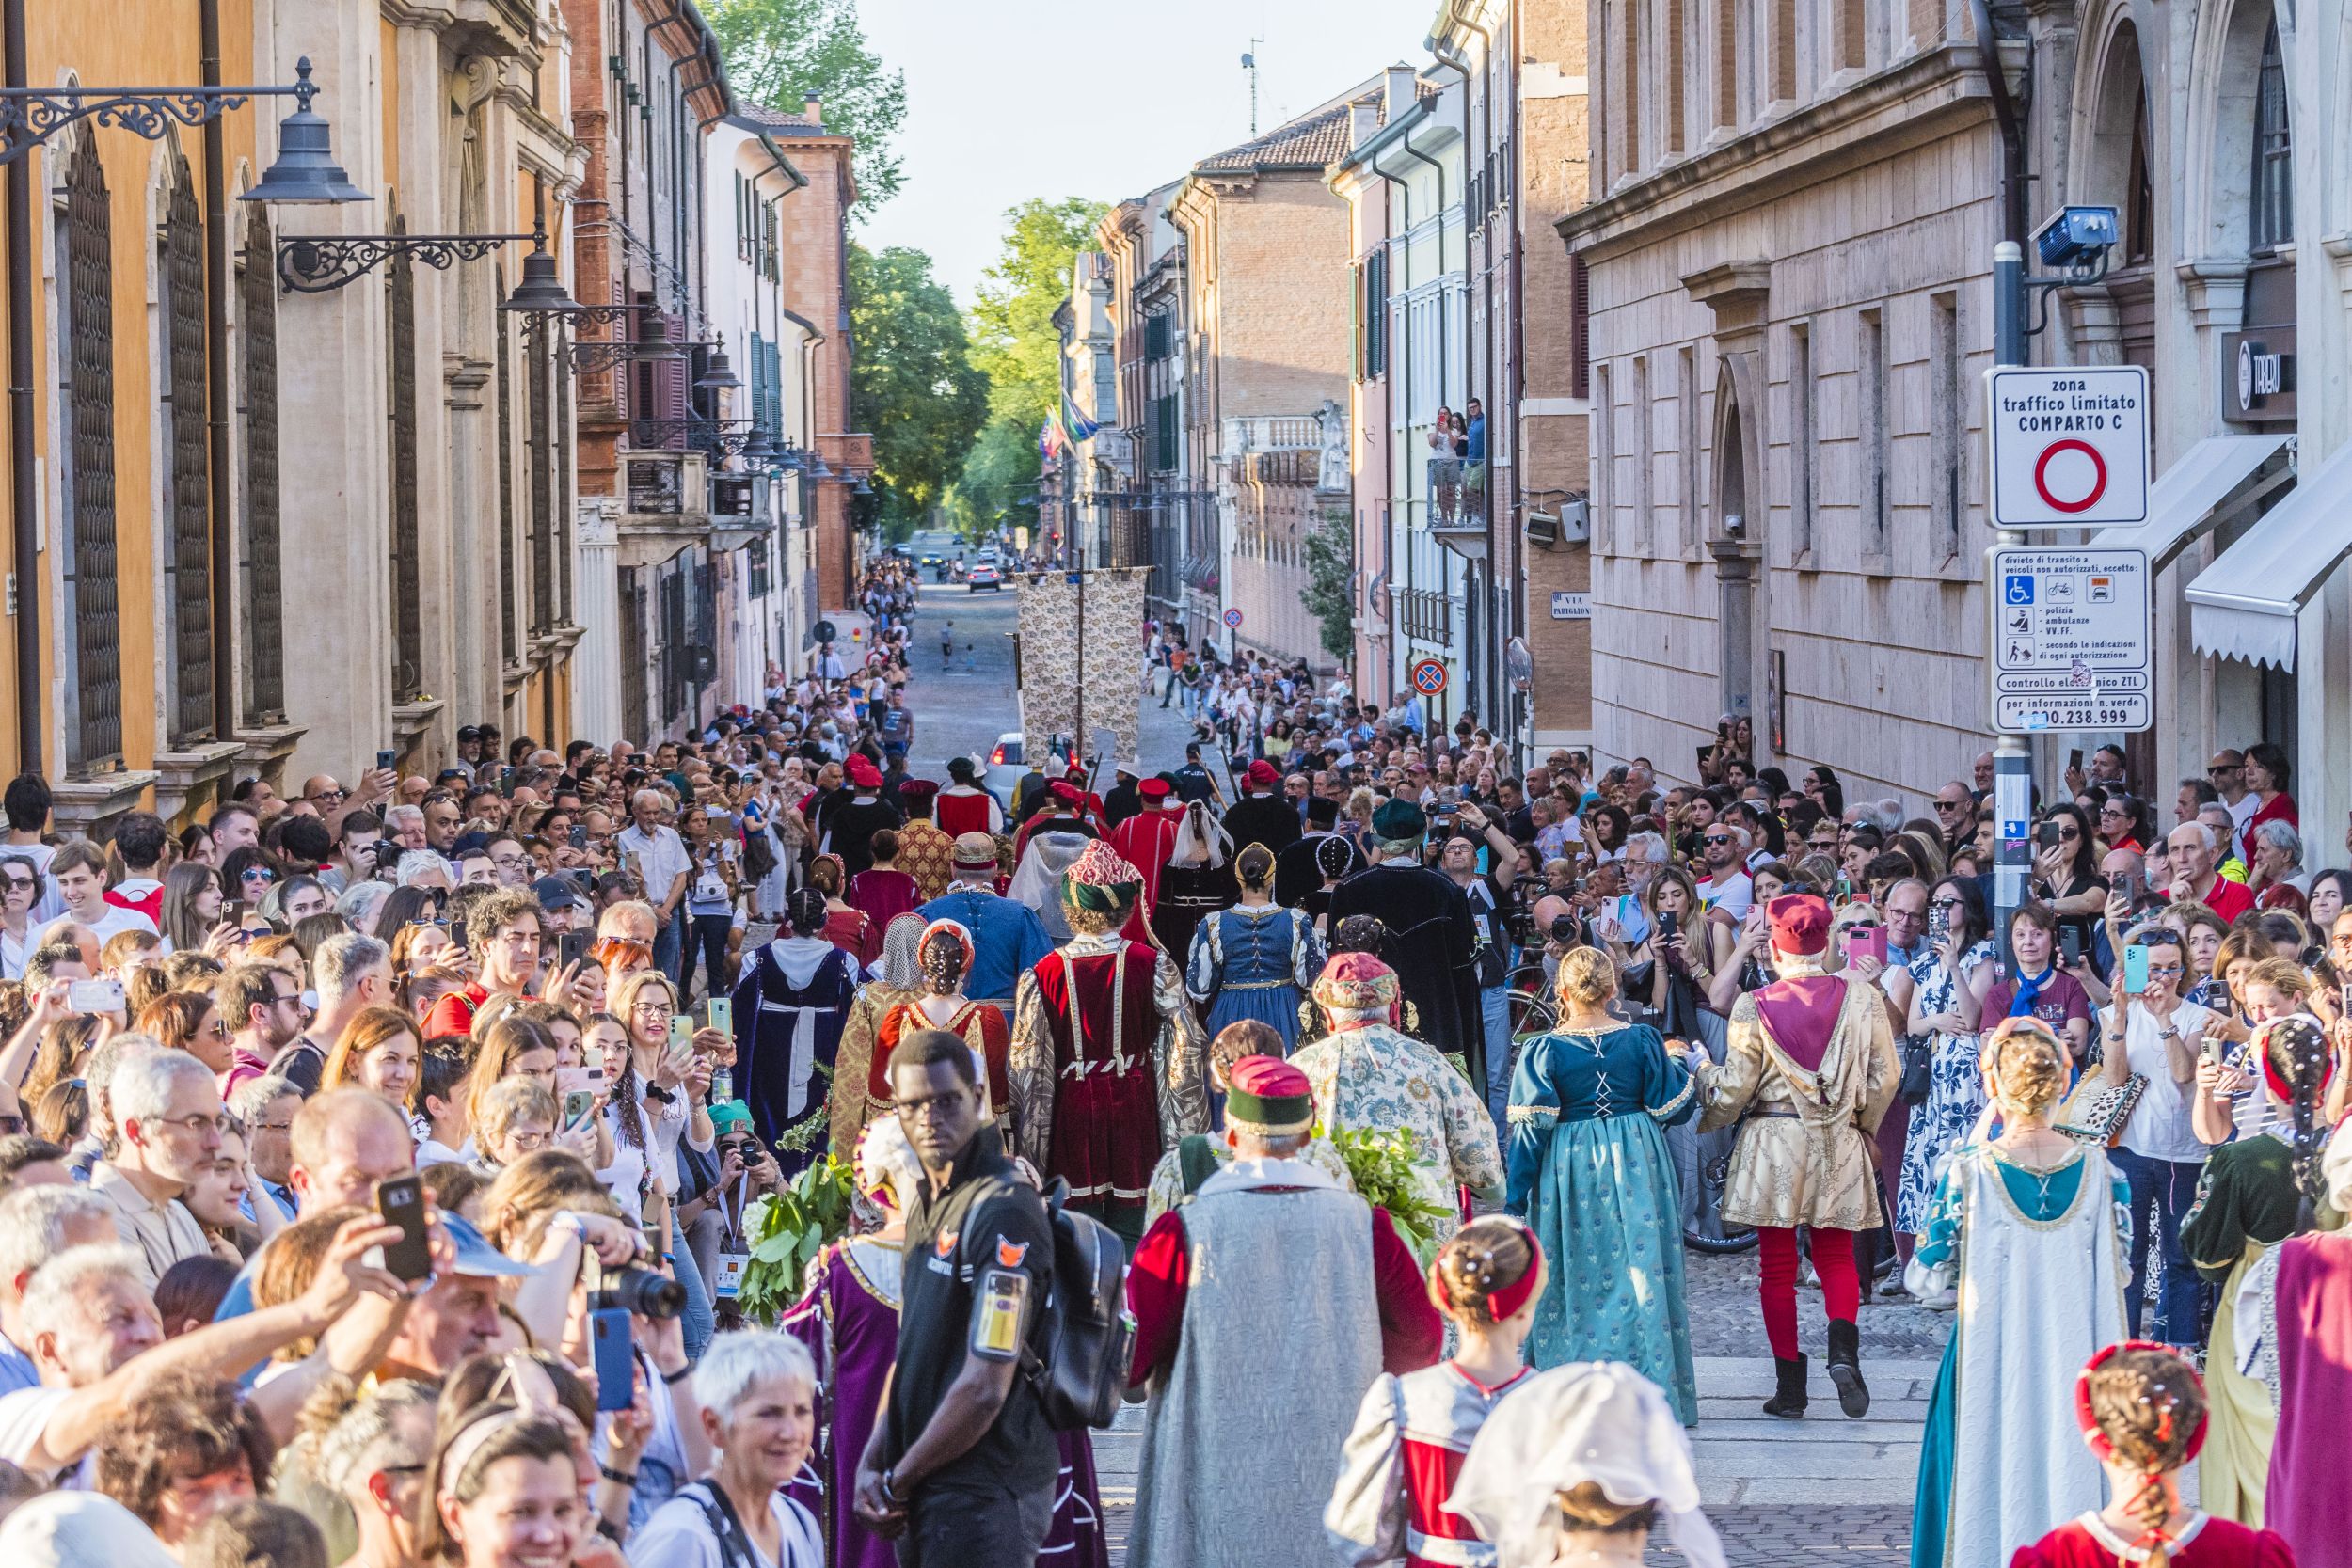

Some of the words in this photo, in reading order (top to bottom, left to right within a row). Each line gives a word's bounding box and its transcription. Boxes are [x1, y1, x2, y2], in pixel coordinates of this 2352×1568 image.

[2253, 354, 2280, 395] TABERU
[2052, 380, 2086, 391] zona
[2003, 395, 2065, 412] traffico
[2072, 394, 2136, 410] limitato
[2019, 415, 2104, 432] COMPARTO
[2112, 414, 2122, 430] C
[2005, 556, 2034, 564] divieto
[2047, 555, 2081, 563] transito
[2005, 564, 2033, 574] veicoli
[2054, 564, 2102, 574] autorizzati,
[2104, 564, 2138, 573] eccetto:
[2045, 607, 2074, 616] polizia
[2049, 652, 2068, 660] ogni
[2006, 677, 2055, 688] controllo
[2058, 677, 2118, 688] elenico
[2121, 676, 2138, 687] ZTL
[2006, 701, 2023, 710] per
[2027, 698, 2094, 708] informazioni
[2032, 709, 2127, 724] 00.238.999
